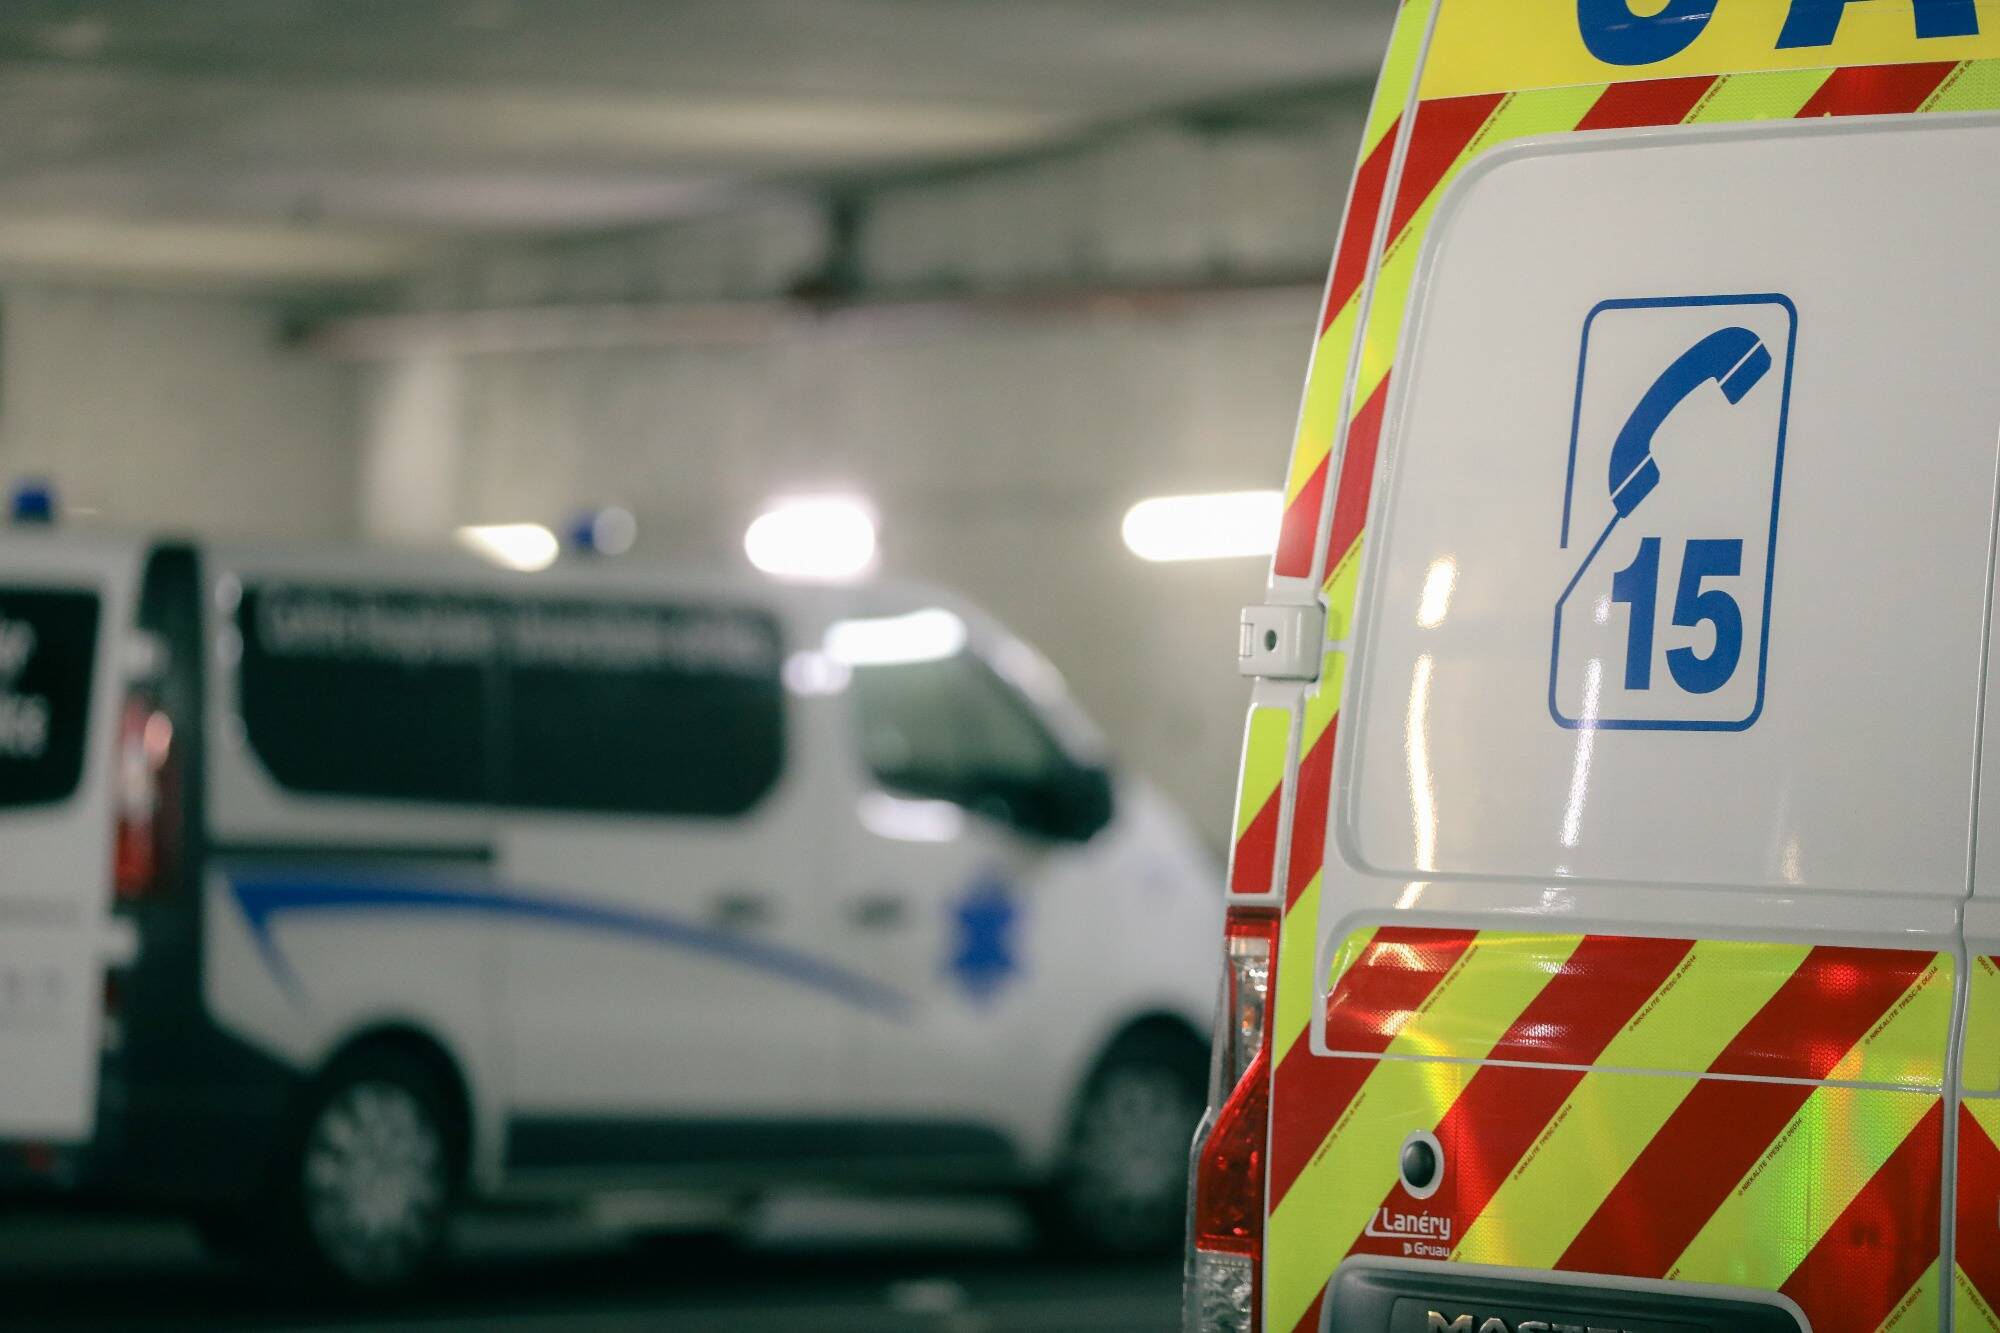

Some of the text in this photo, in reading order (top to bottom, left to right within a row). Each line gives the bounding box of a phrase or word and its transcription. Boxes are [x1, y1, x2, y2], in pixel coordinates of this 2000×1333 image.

[1611, 537, 1743, 694] 15
[1381, 1207, 1451, 1241] Lanéry
[1414, 1242, 1450, 1257] Gruau
